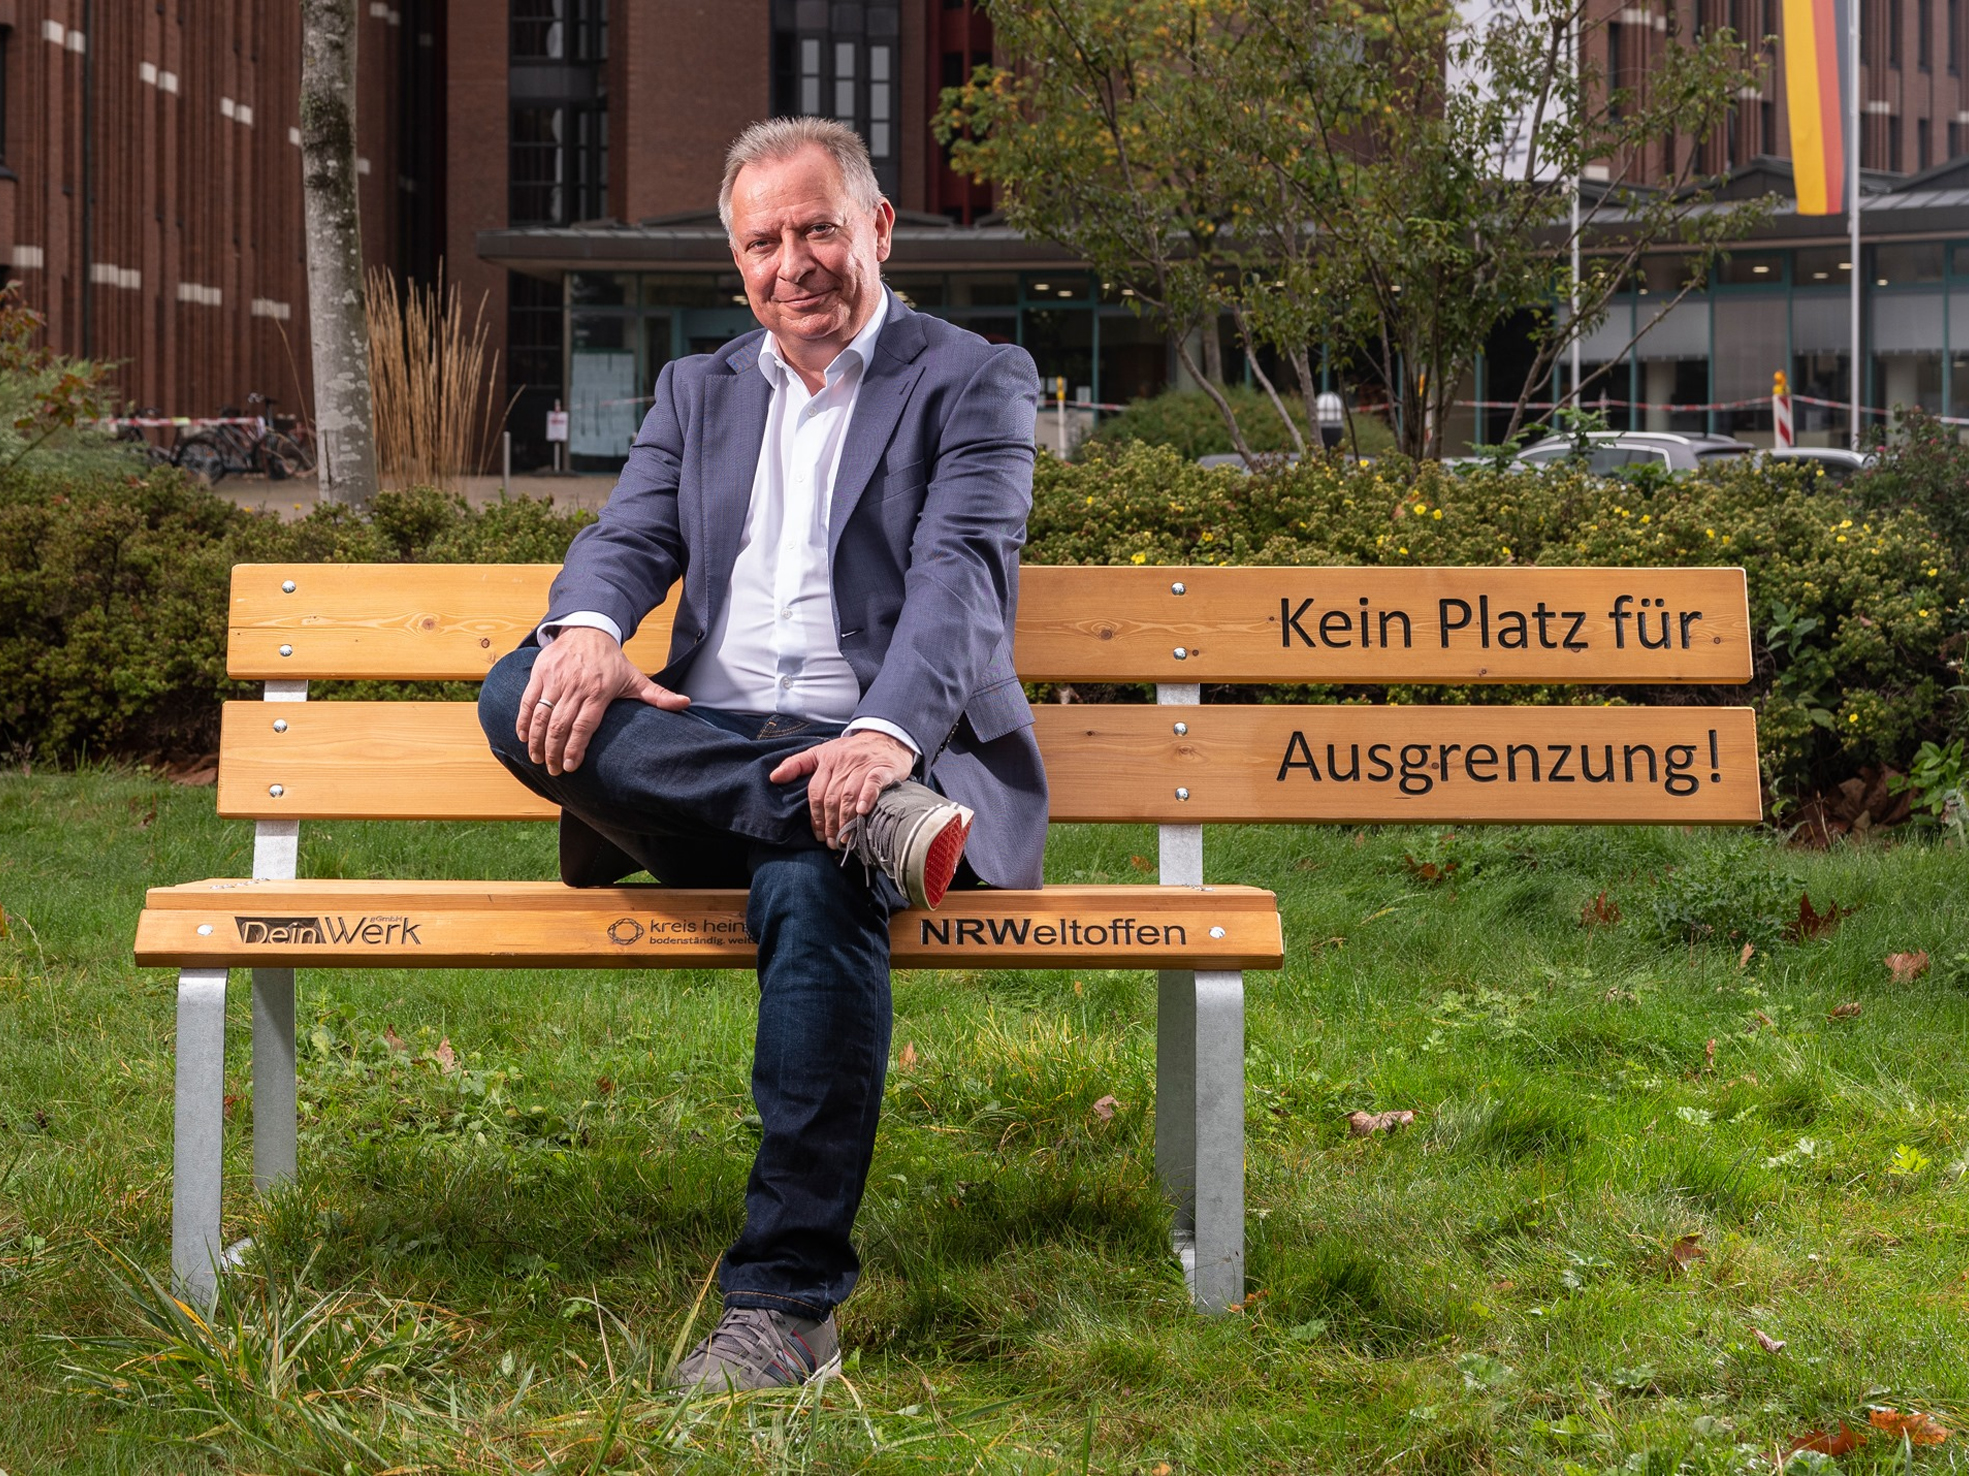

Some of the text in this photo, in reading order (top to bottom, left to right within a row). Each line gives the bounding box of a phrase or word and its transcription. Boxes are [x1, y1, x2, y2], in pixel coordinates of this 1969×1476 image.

[1279, 595, 1702, 649] Kein Platz für
[1277, 729, 1722, 796] Ausgrenzung!
[369, 915, 402, 923] gGmbH
[651, 919, 696, 933] kreis
[650, 936, 725, 946] bodenständig.
[920, 918, 1187, 946] NRWeltoffen
